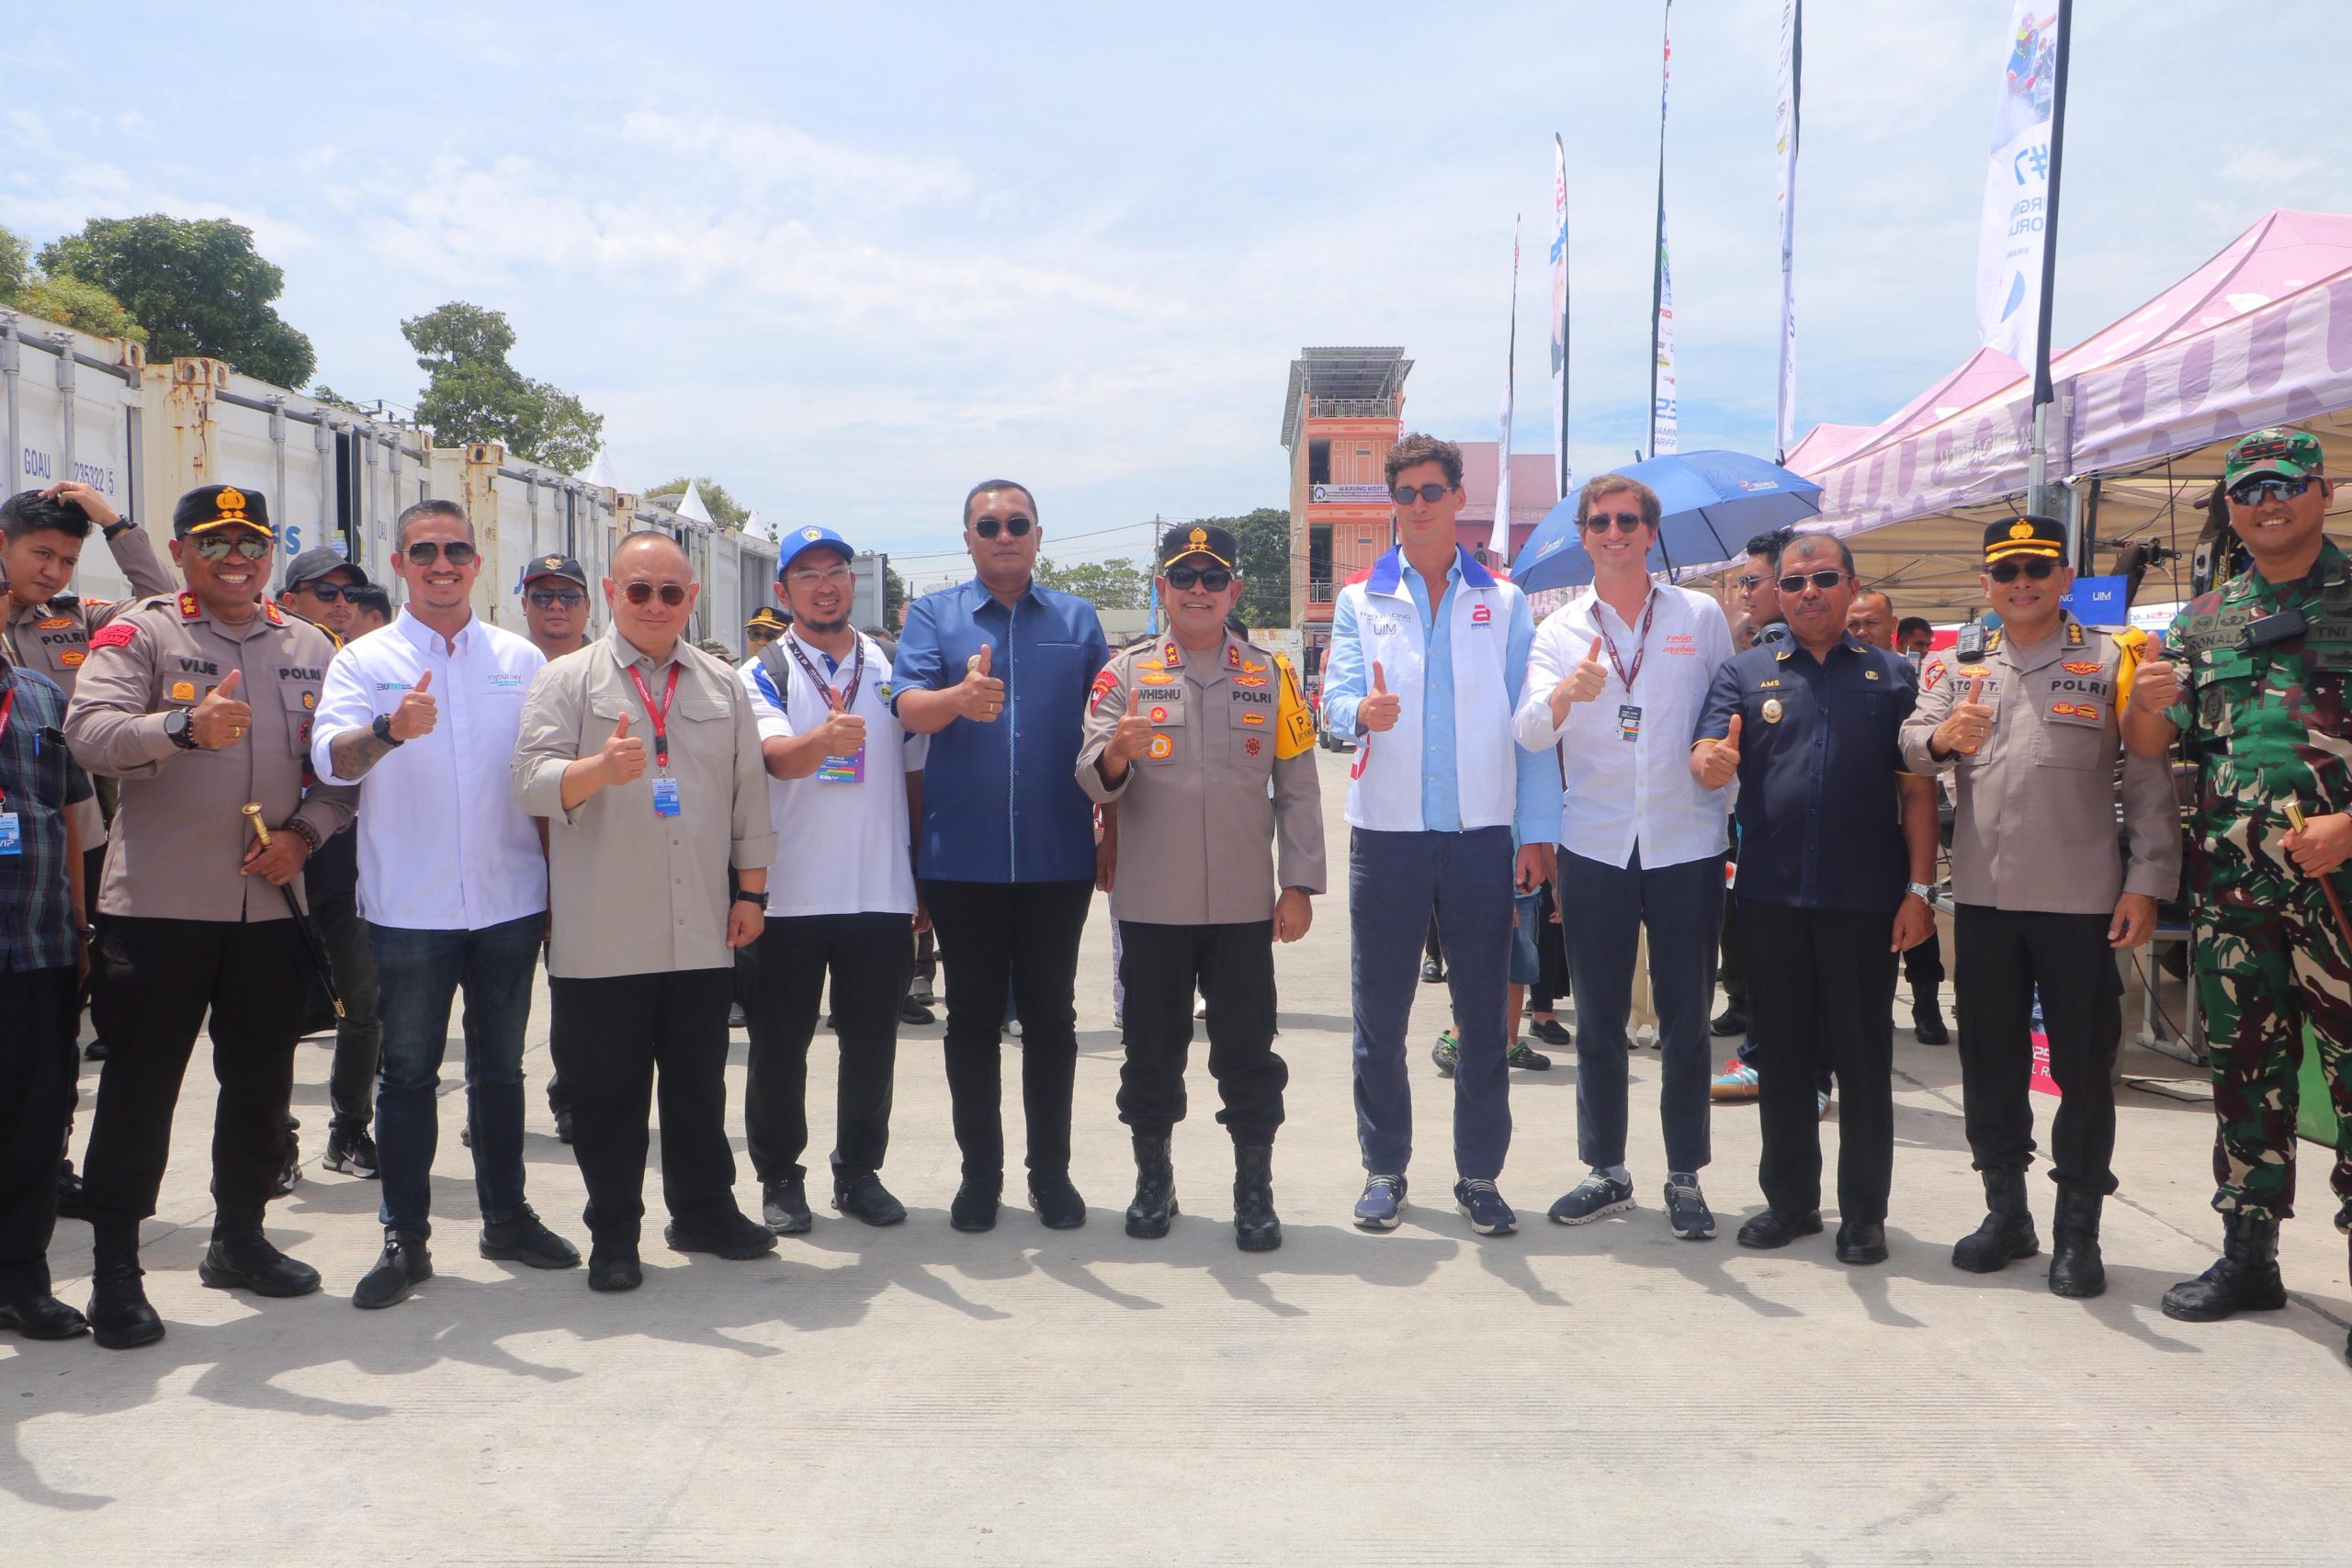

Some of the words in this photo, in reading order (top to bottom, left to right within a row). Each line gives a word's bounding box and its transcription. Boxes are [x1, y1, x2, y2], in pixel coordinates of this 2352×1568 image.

[24, 447, 51, 479] GOAU
[74, 461, 105, 492] 235322
[108, 471, 115, 494] 5
[2092, 592, 2111, 602] UIM
[1374, 624, 1396, 635] UIM
[2316, 626, 2346, 638] TNI
[41, 633, 86, 645] POLRI
[793, 649, 808, 666] VIP
[180, 659, 218, 675] VIJE
[279, 668, 322, 681] POLRI
[1760, 680, 1780, 688] AMS
[1989, 682, 1998, 692] T.
[2051, 680, 2107, 696] POLRI
[1137, 689, 1181, 700] WHISNU
[1232, 691, 1272, 704] POLRI
